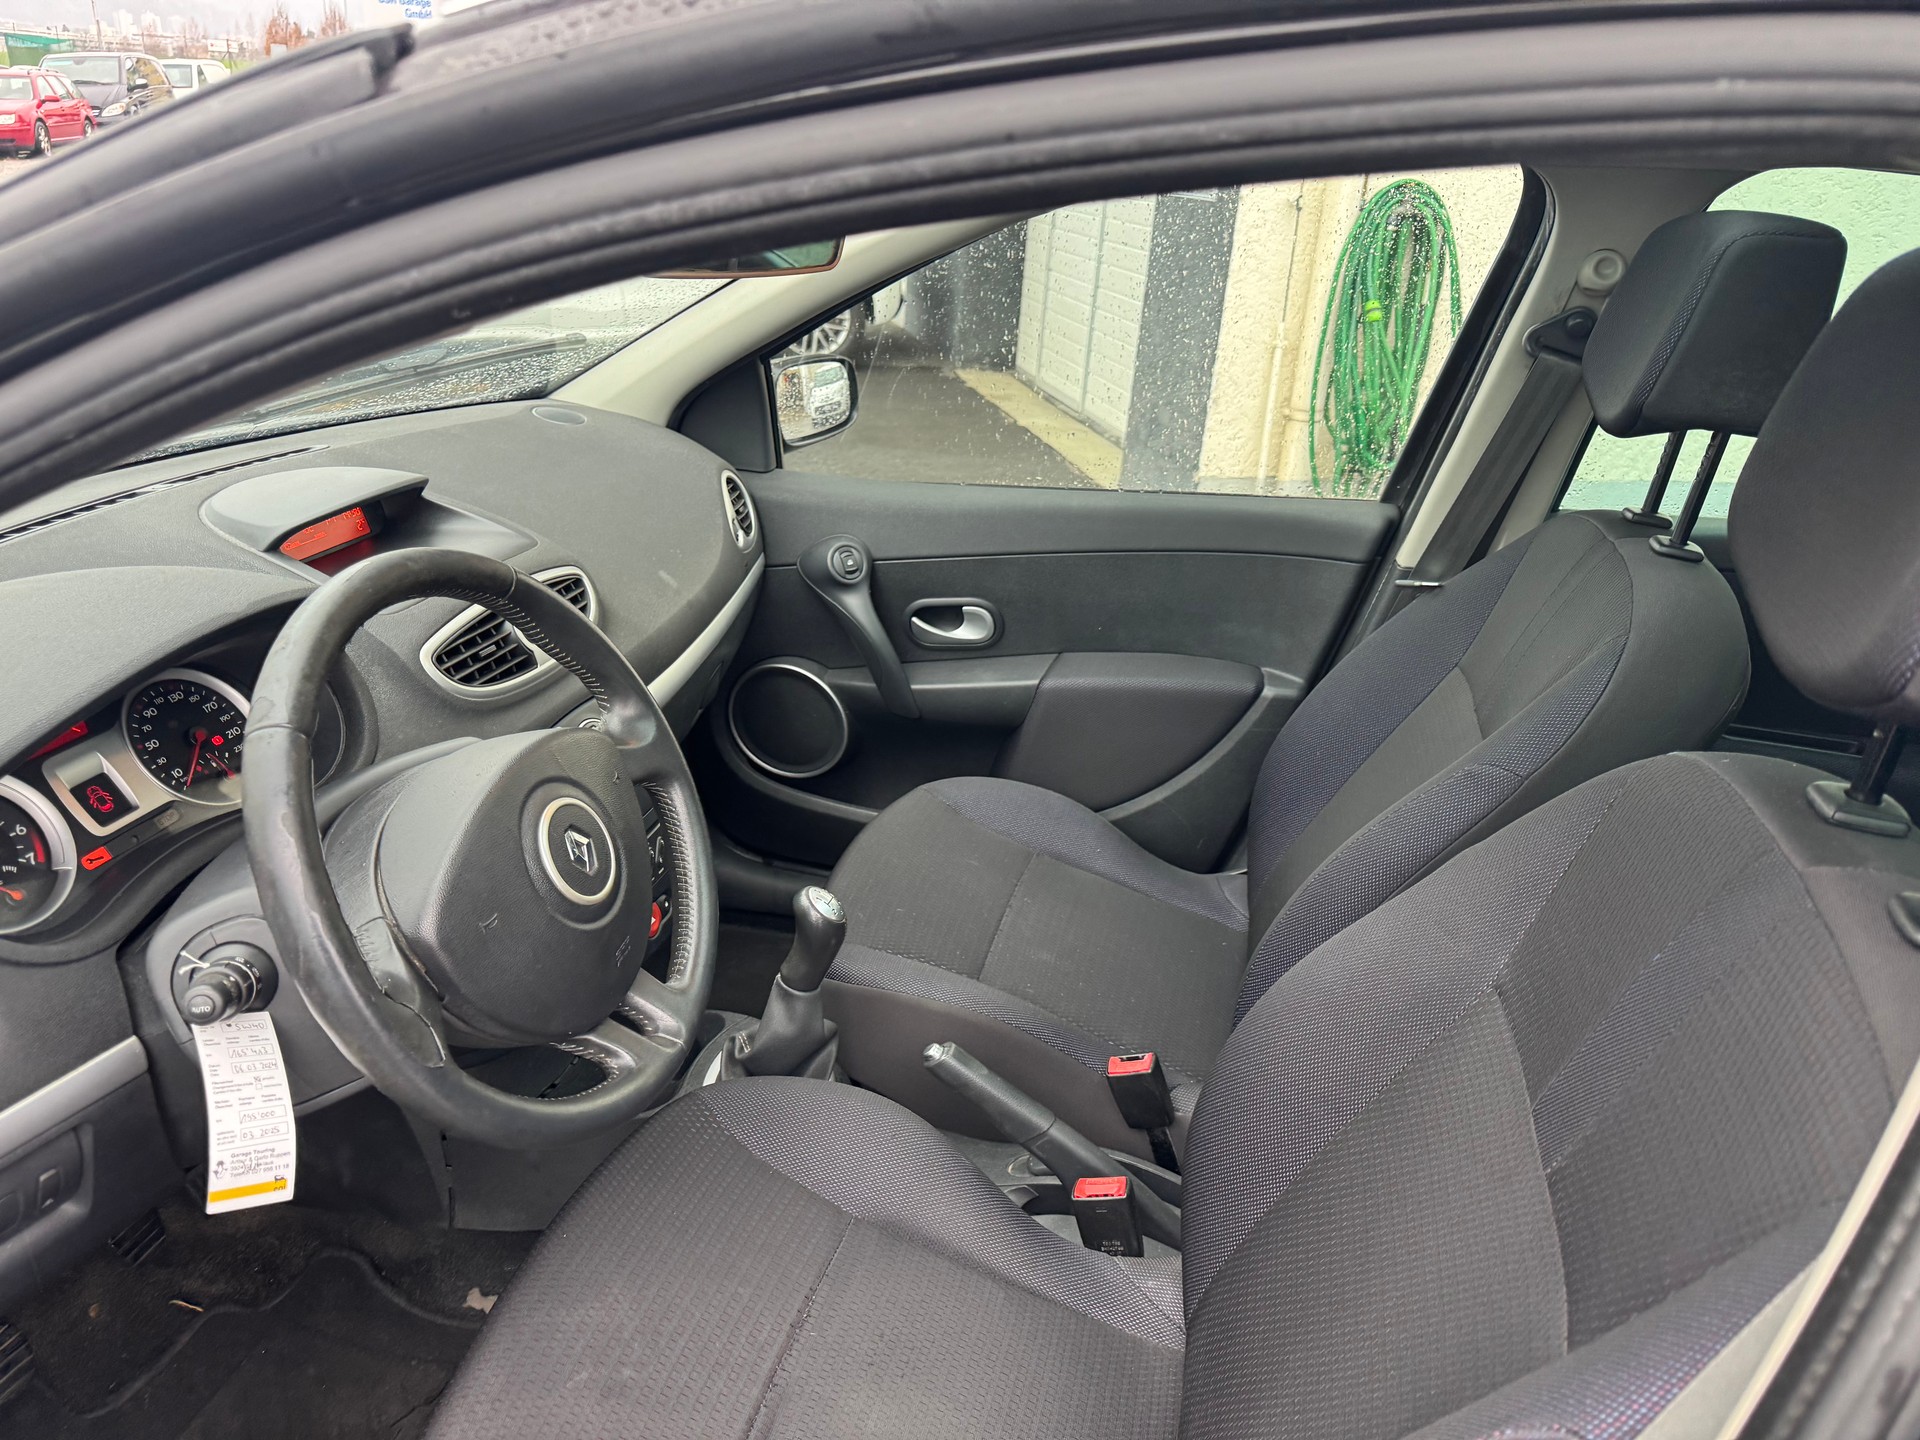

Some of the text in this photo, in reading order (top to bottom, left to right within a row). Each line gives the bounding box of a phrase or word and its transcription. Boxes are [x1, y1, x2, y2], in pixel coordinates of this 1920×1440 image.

[153, 696, 165, 705] 110
[167, 691, 184, 704] 130
[188, 694, 200, 703] 150
[143, 707, 157, 718] 90
[202, 701, 218, 713] 170
[219, 714, 231, 723] 190
[141, 724, 152, 733] 70
[226, 726, 241, 739] 210
[145, 739, 159, 751] 50
[156, 756, 167, 766] 30
[171, 768, 183, 779] 10
[16, 824, 27, 835] 6
[25, 852, 36, 865] 7
[191, 1005, 211, 1014] AUTO
[230, 1150, 252, 1159] Garage
